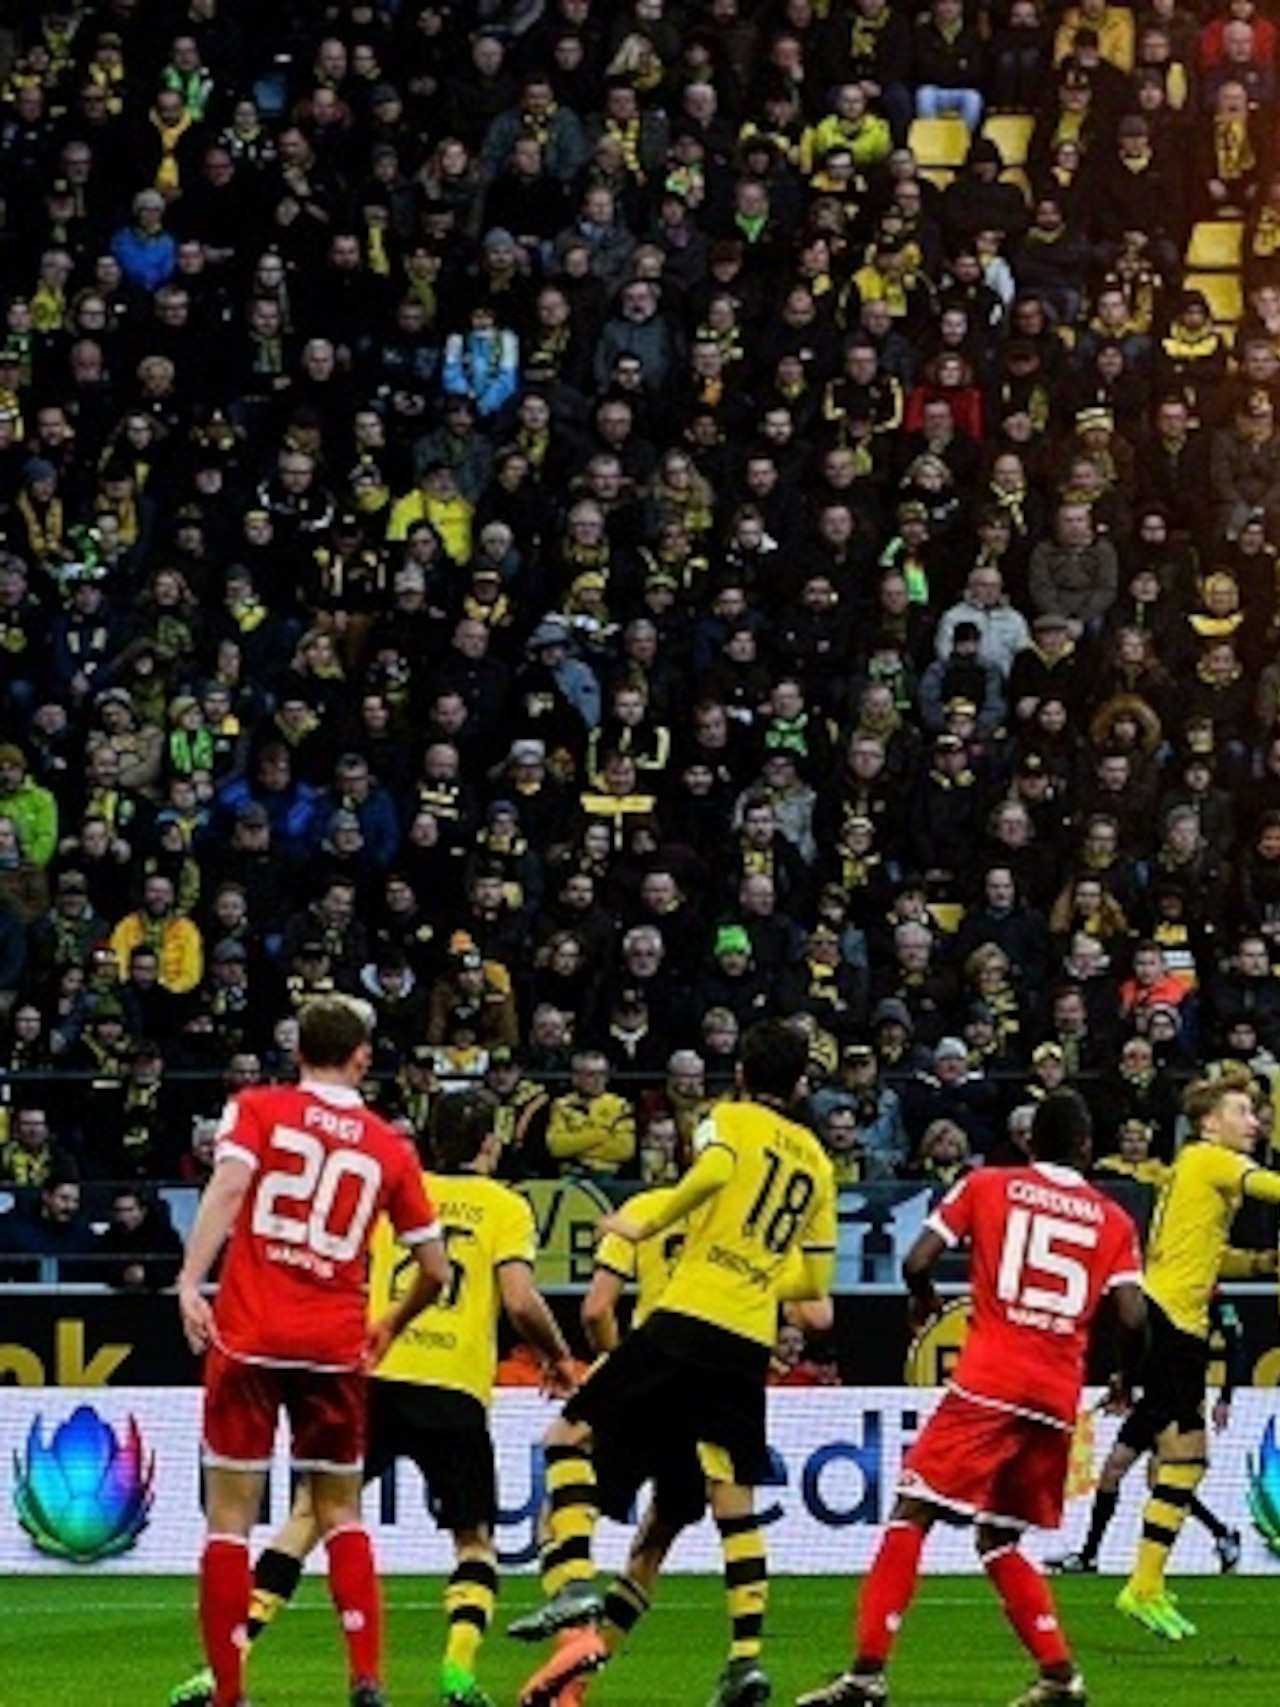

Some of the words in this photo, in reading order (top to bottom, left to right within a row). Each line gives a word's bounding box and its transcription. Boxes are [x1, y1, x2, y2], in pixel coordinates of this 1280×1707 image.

[252, 1123, 382, 1262] 20
[742, 1147, 813, 1254] 18
[997, 1205, 1099, 1318] 15
